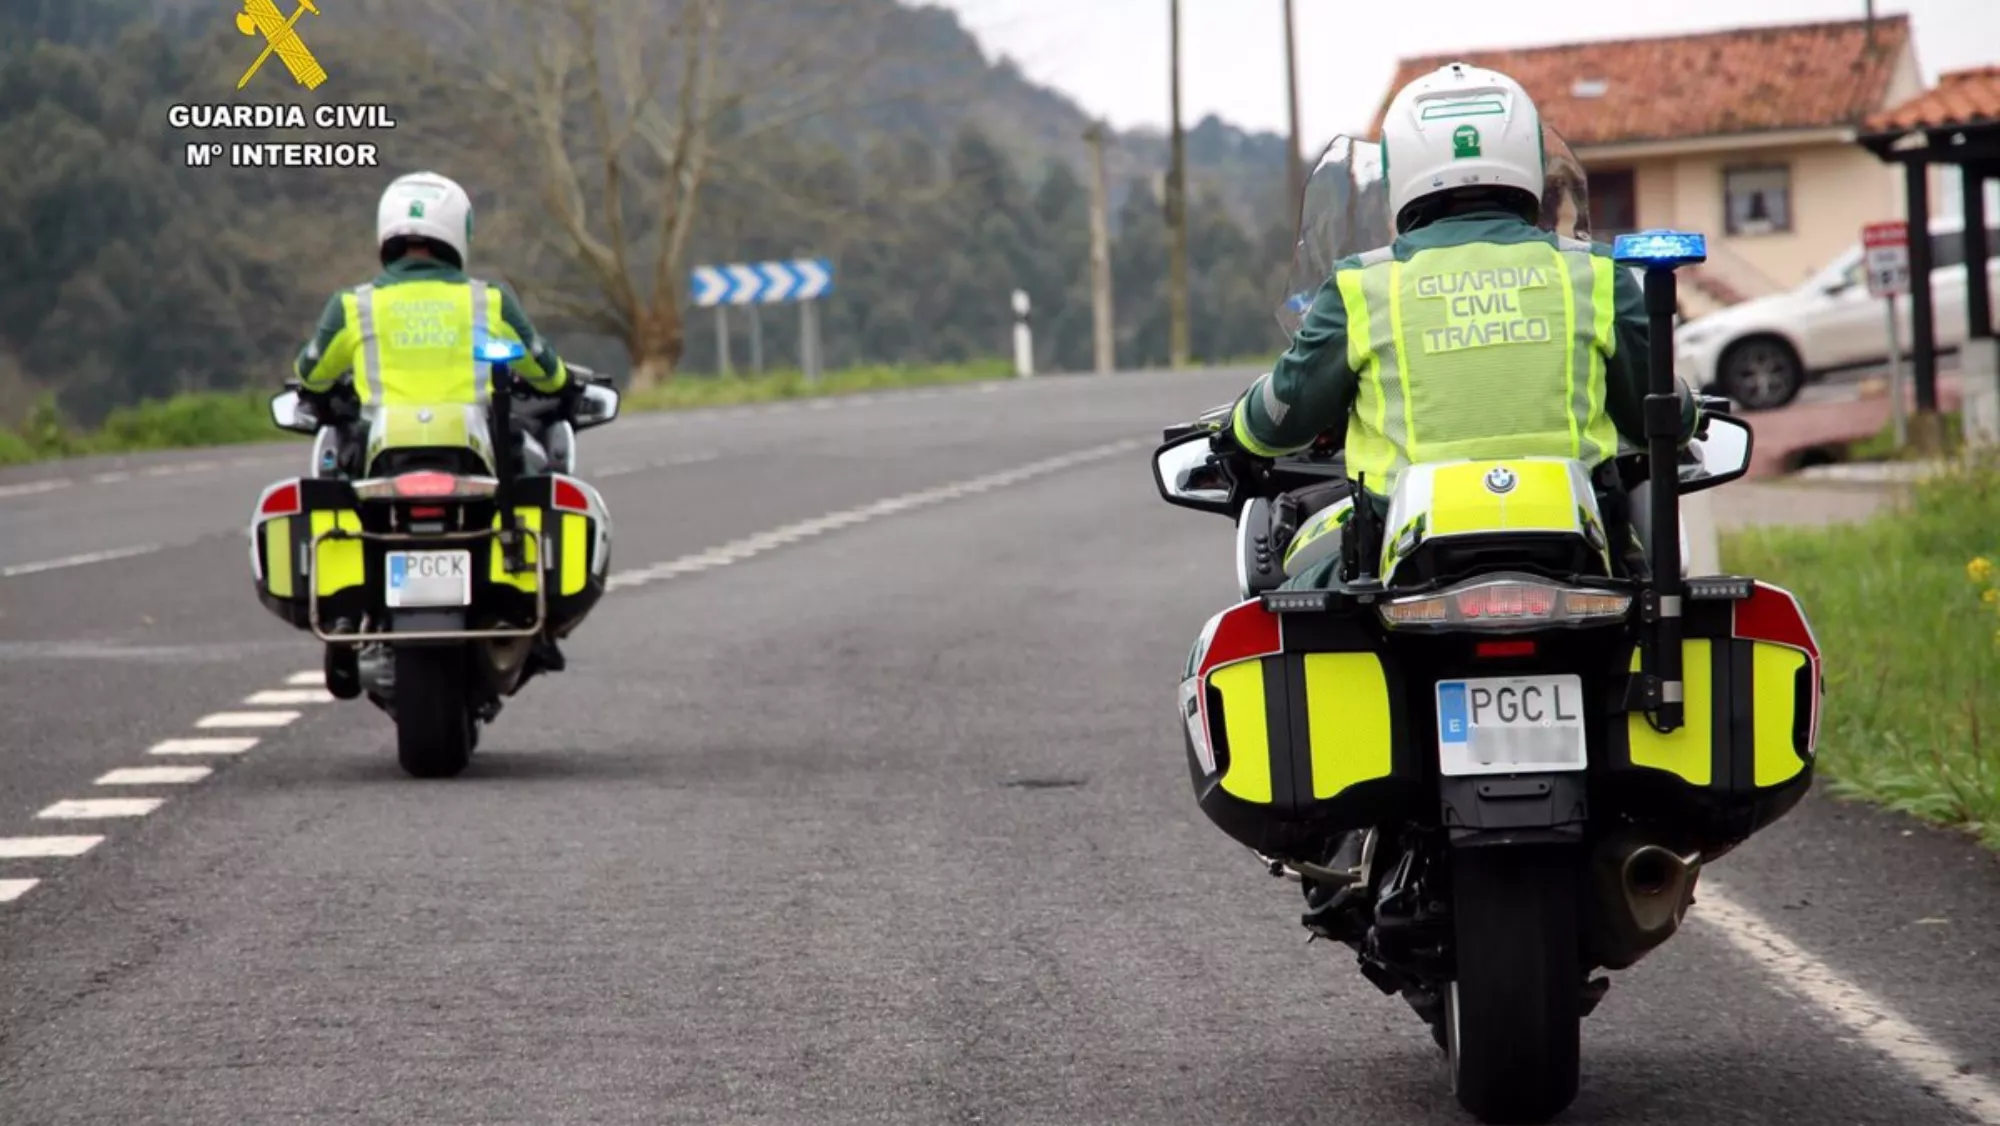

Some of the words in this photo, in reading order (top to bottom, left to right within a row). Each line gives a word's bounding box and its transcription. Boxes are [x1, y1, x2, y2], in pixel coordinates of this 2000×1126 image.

[1417, 267, 1545, 296] GUARDIA
[1452, 293, 1517, 317] CIVIL
[1426, 319, 1547, 350] TRÁFICO
[1450, 718, 1461, 733] E
